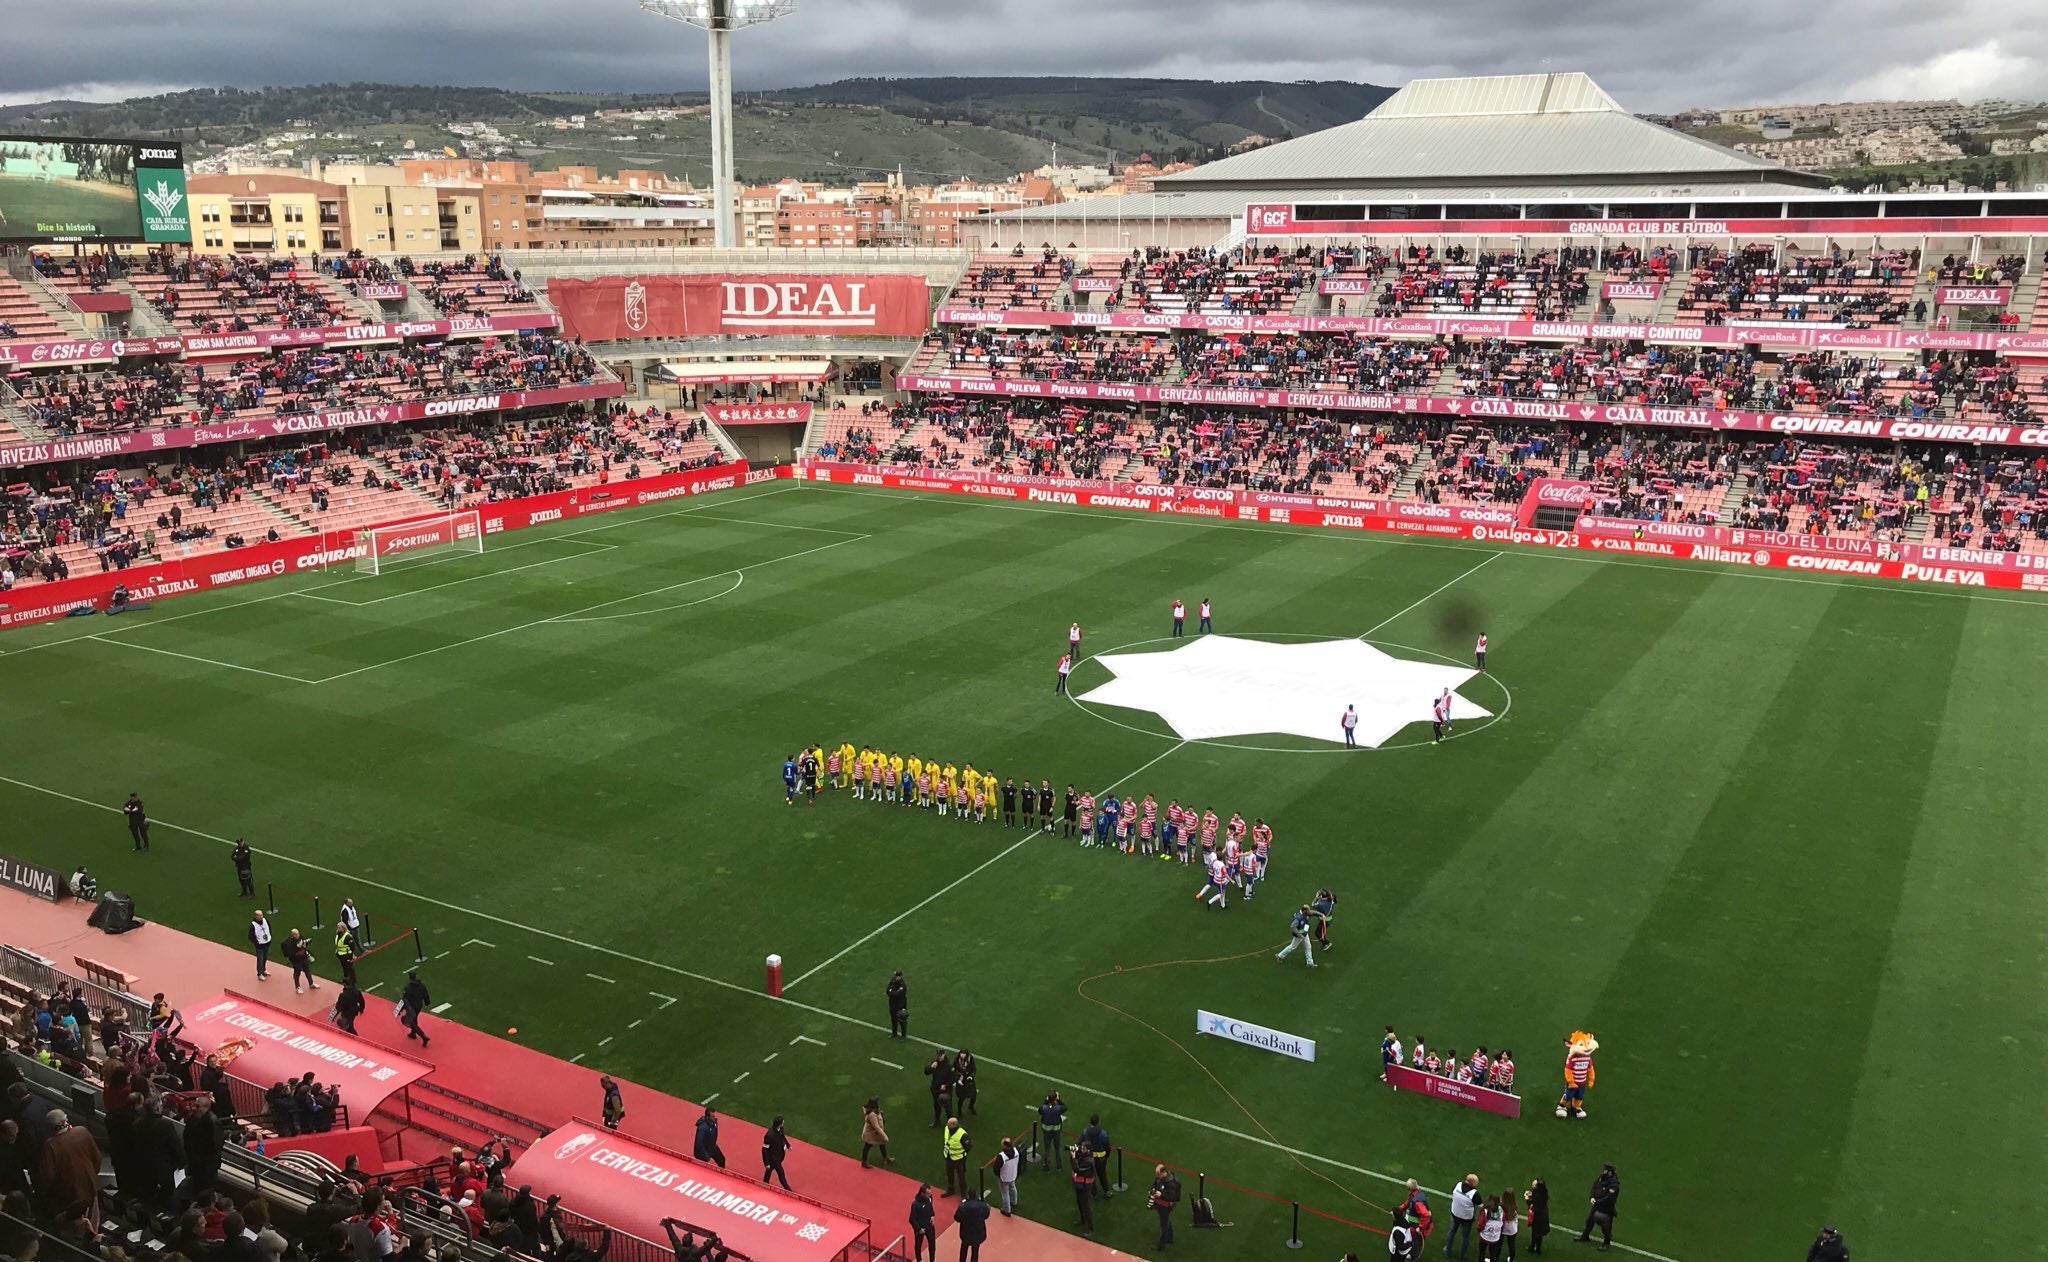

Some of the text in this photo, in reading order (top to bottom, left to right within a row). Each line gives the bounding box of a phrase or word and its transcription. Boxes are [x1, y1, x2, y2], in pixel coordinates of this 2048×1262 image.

[164, 217, 188, 225] RURAL
[1263, 211, 1288, 225] GCF
[37, 223, 96, 232] Dice la historia
[1569, 220, 1729, 233] GRANADA CLUB DE FÚTBOL
[365, 285, 403, 296] IDEAL
[1077, 279, 1113, 288] IDEAL
[1325, 281, 1365, 291] IDEAL
[1608, 284, 1655, 295] IDEAL
[722, 281, 876, 317] IDEAL
[1945, 289, 2001, 301] IDEAL
[451, 317, 493, 331] IDEAL
[950, 310, 1005, 324] Granada Hoy
[1144, 315, 1181, 325] CASTOR
[1206, 316, 1245, 327] CASTOR
[1263, 319, 1301, 329] CaixaBank
[346, 324, 387, 340] LEYVA
[1328, 321, 1366, 330] CaixaBank
[1393, 321, 1433, 332] CaixaBank
[1461, 322, 1501, 333] CaixaBank
[1532, 324, 1702, 340] GRANADA SIEMPRE CONTIGO
[188, 335, 257, 350] MESÓN SAN CAYETANO
[1750, 331, 1798, 342] CaixaBank
[1833, 333, 1882, 345] CaixaBank
[157, 341, 182, 349] TIPSA
[916, 378, 952, 389] PULEVA
[960, 380, 996, 391] PULEVA
[1005, 382, 1041, 394] PULEVA
[1051, 384, 1088, 396] PULEVA
[1097, 386, 1135, 398] PULEVA
[1158, 388, 1202, 401] CERVEZAS
[1205, 390, 1256, 404] ALHAMBRA
[424, 396, 500, 416] COVIRAN
[1287, 394, 1335, 407] CERVEZAS
[1337, 395, 1392, 409] ALHAMBRA
[1470, 400, 1569, 418] CAJA RURAL
[287, 408, 376, 432] CAJA RURAL
[1605, 406, 1711, 426] CAJA RURAL
[194, 422, 257, 442] Eterna Lucha
[1770, 415, 1884, 436] COVIRAN
[1888, 421, 2011, 443] COVIRAN
[0, 445, 50, 465] RVEZAS
[54, 437, 121, 459] ALHAMBRA
[745, 467, 777, 483] IDEAL
[1003, 474, 1048, 486] grupo2000
[970, 484, 1018, 497] CAJA RURAL
[1056, 478, 1103, 489] grupo2000
[647, 486, 686, 501] MotorDOS
[1028, 487, 1078, 504] PULEVA
[1135, 485, 1175, 498] CASTOR
[1192, 488, 1234, 501] CASTOR
[1090, 495, 1151, 509] COVIRAN
[1172, 501, 1222, 516] CaixaBank
[1316, 498, 1377, 511] GRUPO LUNA
[1400, 505, 1451, 518] ceballos
[1459, 508, 1513, 523] ceballos
[1396, 521, 1459, 534] CERVEZAS ALHAMBRA
[1489, 526, 1532, 543] LaLiga
[1647, 522, 1705, 538] CHIKITO
[382, 531, 440, 554] SPORTIUM
[1604, 539, 1675, 556] CAJA RURAL
[1764, 533, 1873, 553] HOTEL LUNA
[296, 544, 368, 568] COVIRAN
[1689, 545, 1752, 564] Allianz
[1939, 550, 2005, 565] BERNER
[1786, 555, 1882, 575] COVIRAN
[210, 562, 271, 585] TURISMOS DIGASA
[1901, 563, 1986, 586] PULEVA
[158, 577, 198, 597] RURAL
[14, 598, 94, 622] CERVEZAS ALHAMBRA
[15, 864, 54, 896] LUNA
[224, 1011, 295, 1042] CERVEZAS
[285, 1035, 365, 1069] ALHAMBRA
[1229, 1023, 1303, 1056] CaixaBank
[589, 1147, 798, 1226] CERVEZAS ALHAMBRA SIN
